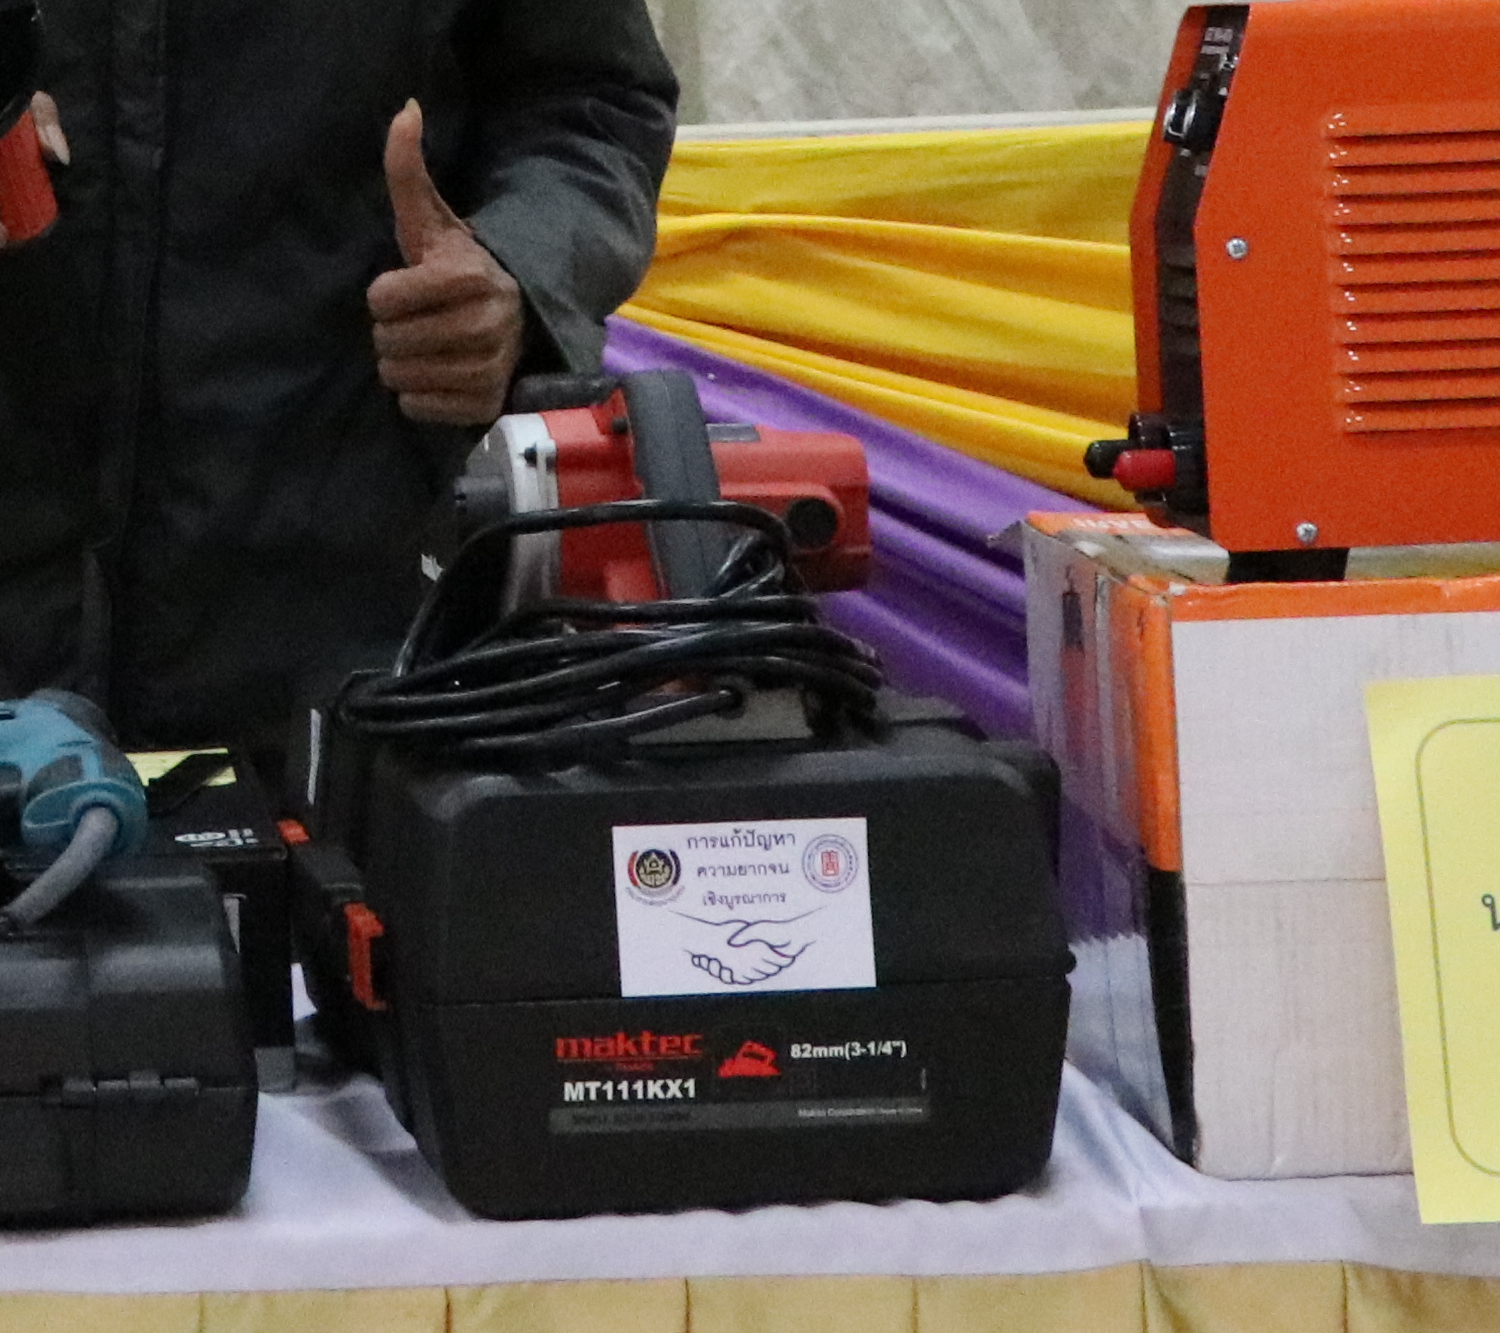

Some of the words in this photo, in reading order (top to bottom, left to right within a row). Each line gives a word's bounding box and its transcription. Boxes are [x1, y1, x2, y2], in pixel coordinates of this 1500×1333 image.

[687, 828, 796, 851] การแก้ปัญหา
[555, 1029, 703, 1061] maktec
[563, 1078, 697, 1103] MT111KX1
